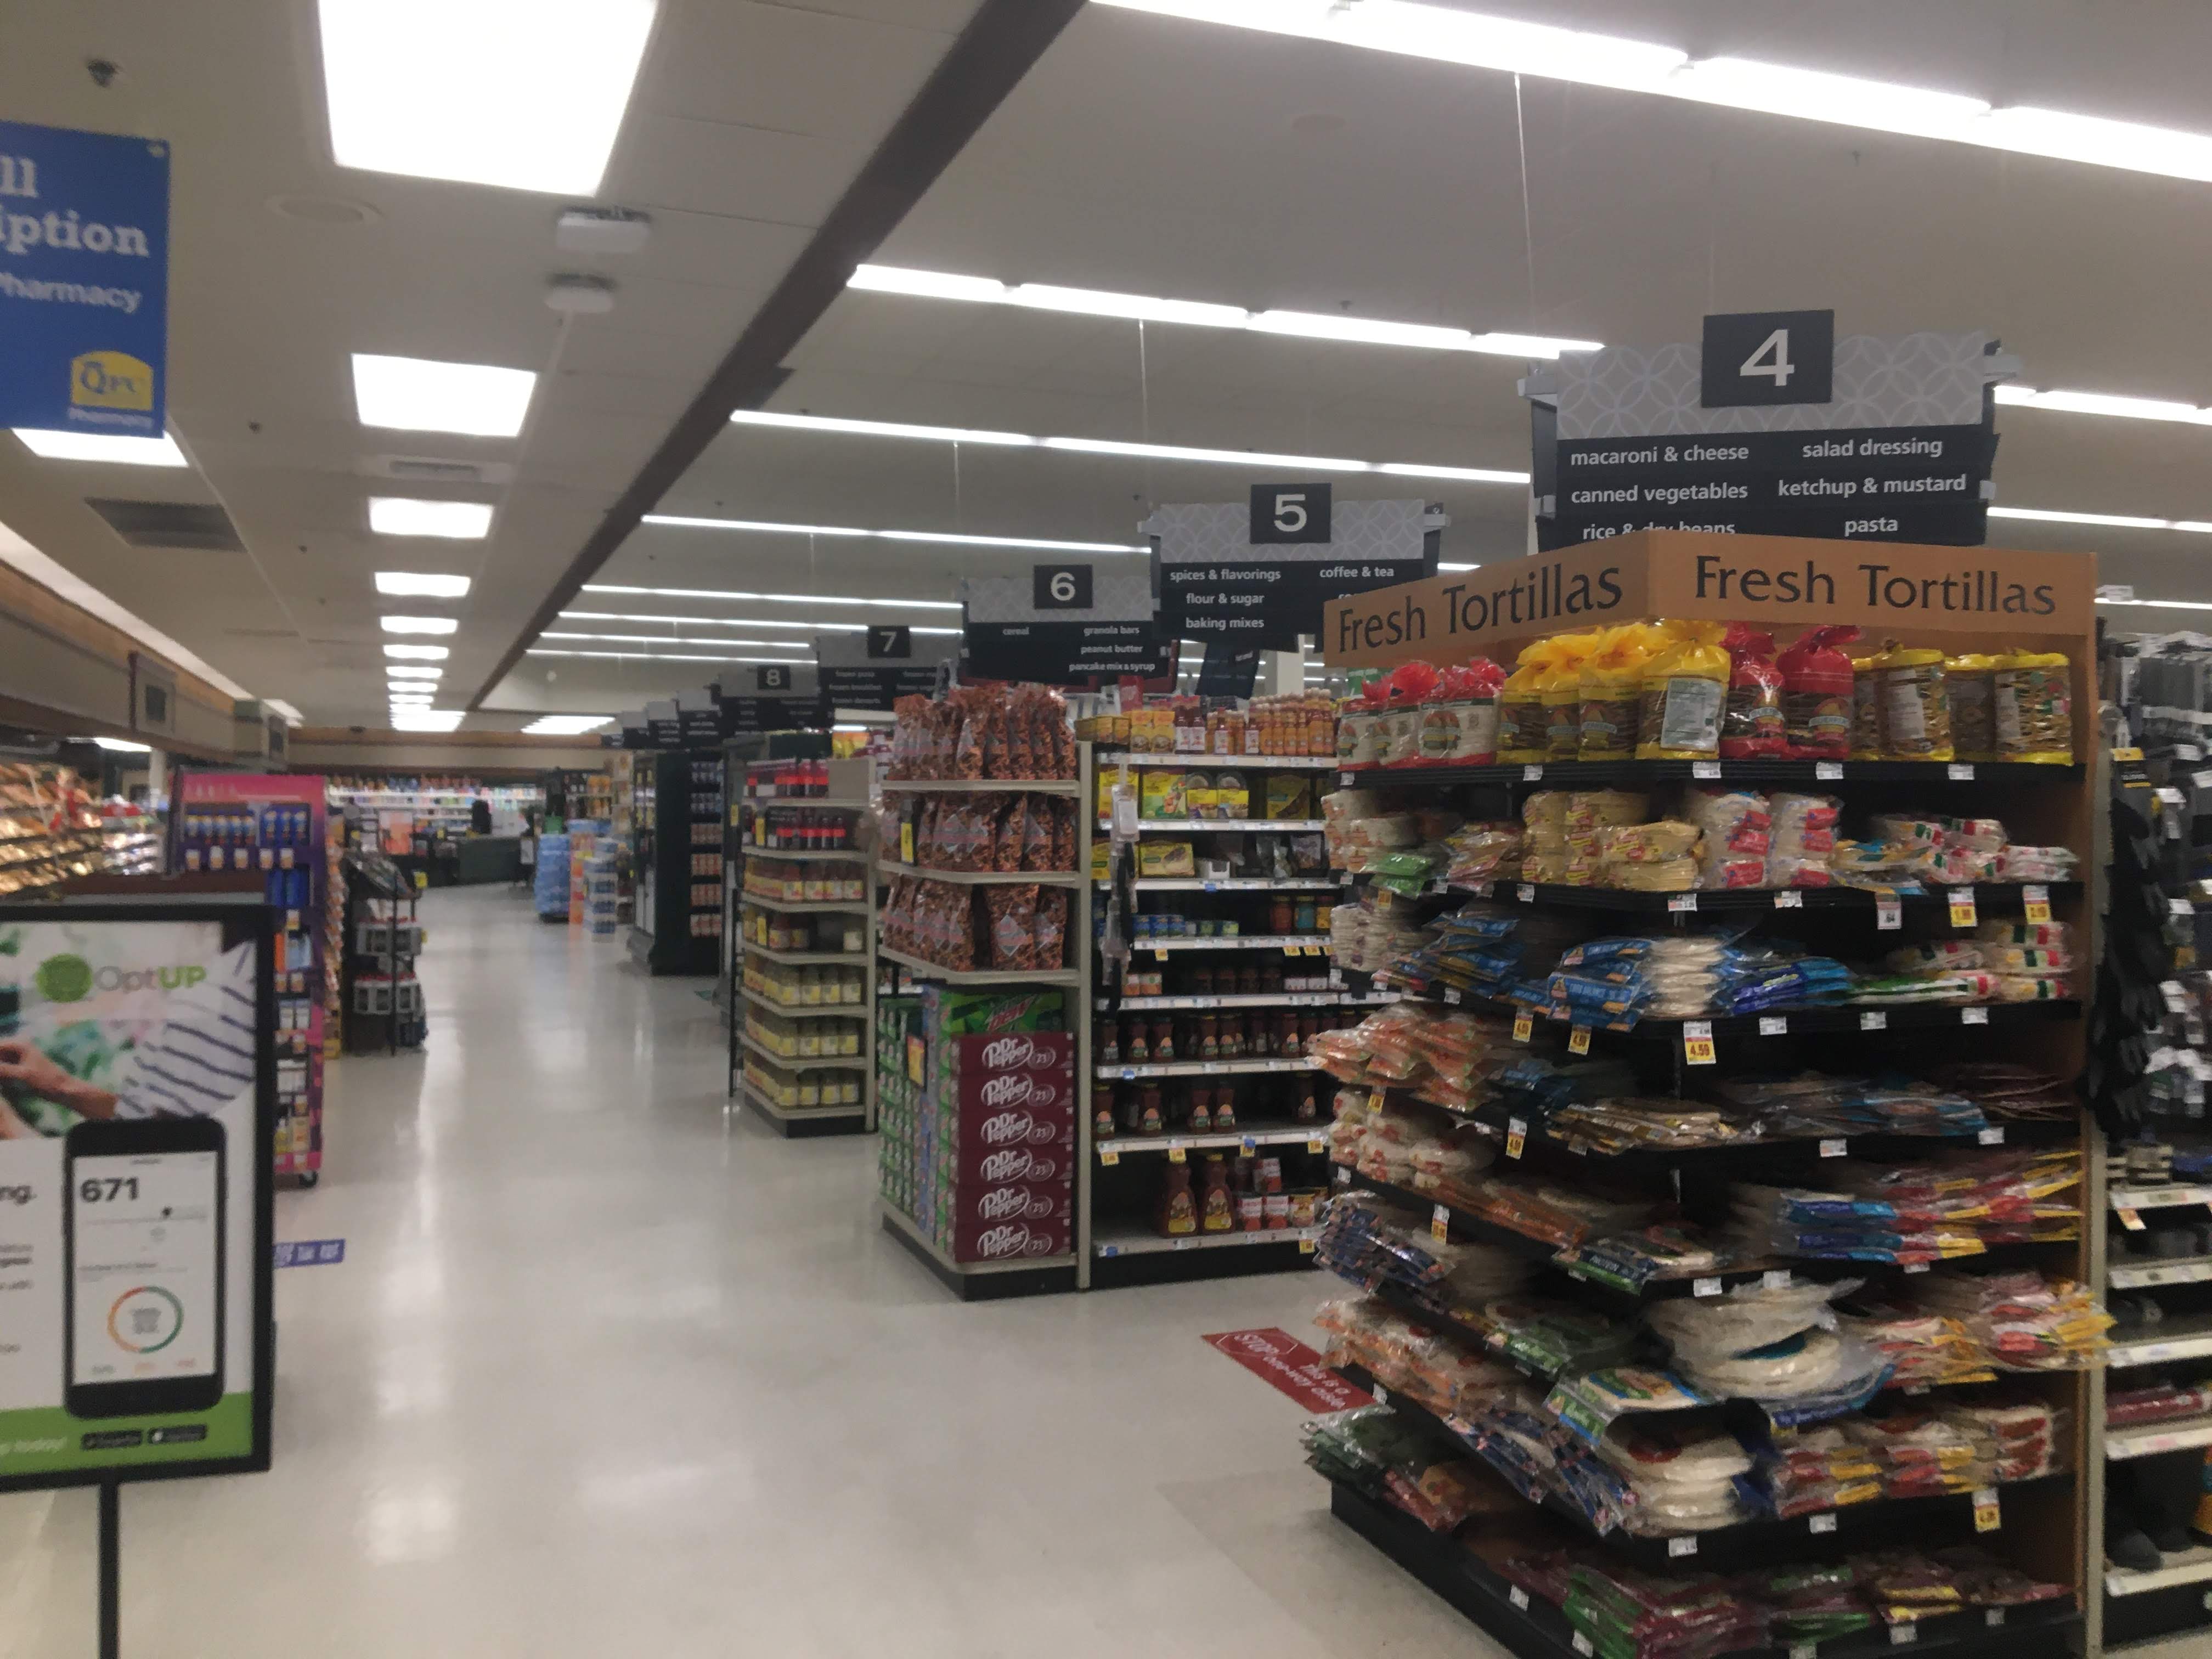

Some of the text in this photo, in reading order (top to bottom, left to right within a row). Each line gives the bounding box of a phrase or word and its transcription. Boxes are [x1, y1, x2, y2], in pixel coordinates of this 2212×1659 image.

[0, 206, 149, 257] ption
[1740, 329, 1794, 386] 4
[1570, 445, 1749, 466] macaroni & cheese
[1802, 437, 1943, 459] salad dressing
[1571, 483, 1748, 507] canned vegetables
[1778, 475, 1966, 502] ketchup & mustard
[1274, 494, 1307, 532] 5
[1583, 523, 1615, 539] rice
[1844, 517, 1898, 538] pasta
[1170, 568, 1280, 582] spices & flavorings
[1319, 567, 1394, 578] coffee & tea
[1050, 573, 1075, 601] 6
[1695, 555, 2056, 615] Fresh Tortillas
[1186, 594, 1265, 606] flour & sugar
[1339, 563, 1623, 653] Fresh Tortillas
[1003, 627, 1029, 635] cereal
[1084, 625, 1141, 636] granola bars
[1186, 617, 1264, 629] baking mixes
[880, 632, 897, 652] 7
[1081, 645, 1143, 654] peanut butter
[767, 669, 781, 686] 8
[1069, 663, 1104, 672] pancake
[1106, 662, 1122, 670] mix
[1130, 663, 1155, 672] syrup
[988, 1042, 1030, 1068] Pepper
[1001, 1038, 1018, 1052] Dr
[988, 1080, 1028, 1105] Pepper
[1000, 1076, 1017, 1090] Dr
[988, 1118, 1028, 1143] Pepper
[1000, 1113, 1017, 1127] Dr
[988, 1155, 1028, 1180] Pepper
[1000, 1150, 1017, 1165] Dr
[81, 1177, 139, 1202] 671
[997, 1188, 1014, 1203] Dr
[985, 1193, 1025, 1218] Pepper
[996, 1226, 1014, 1239] Dr
[984, 1231, 1025, 1257] Pepper
